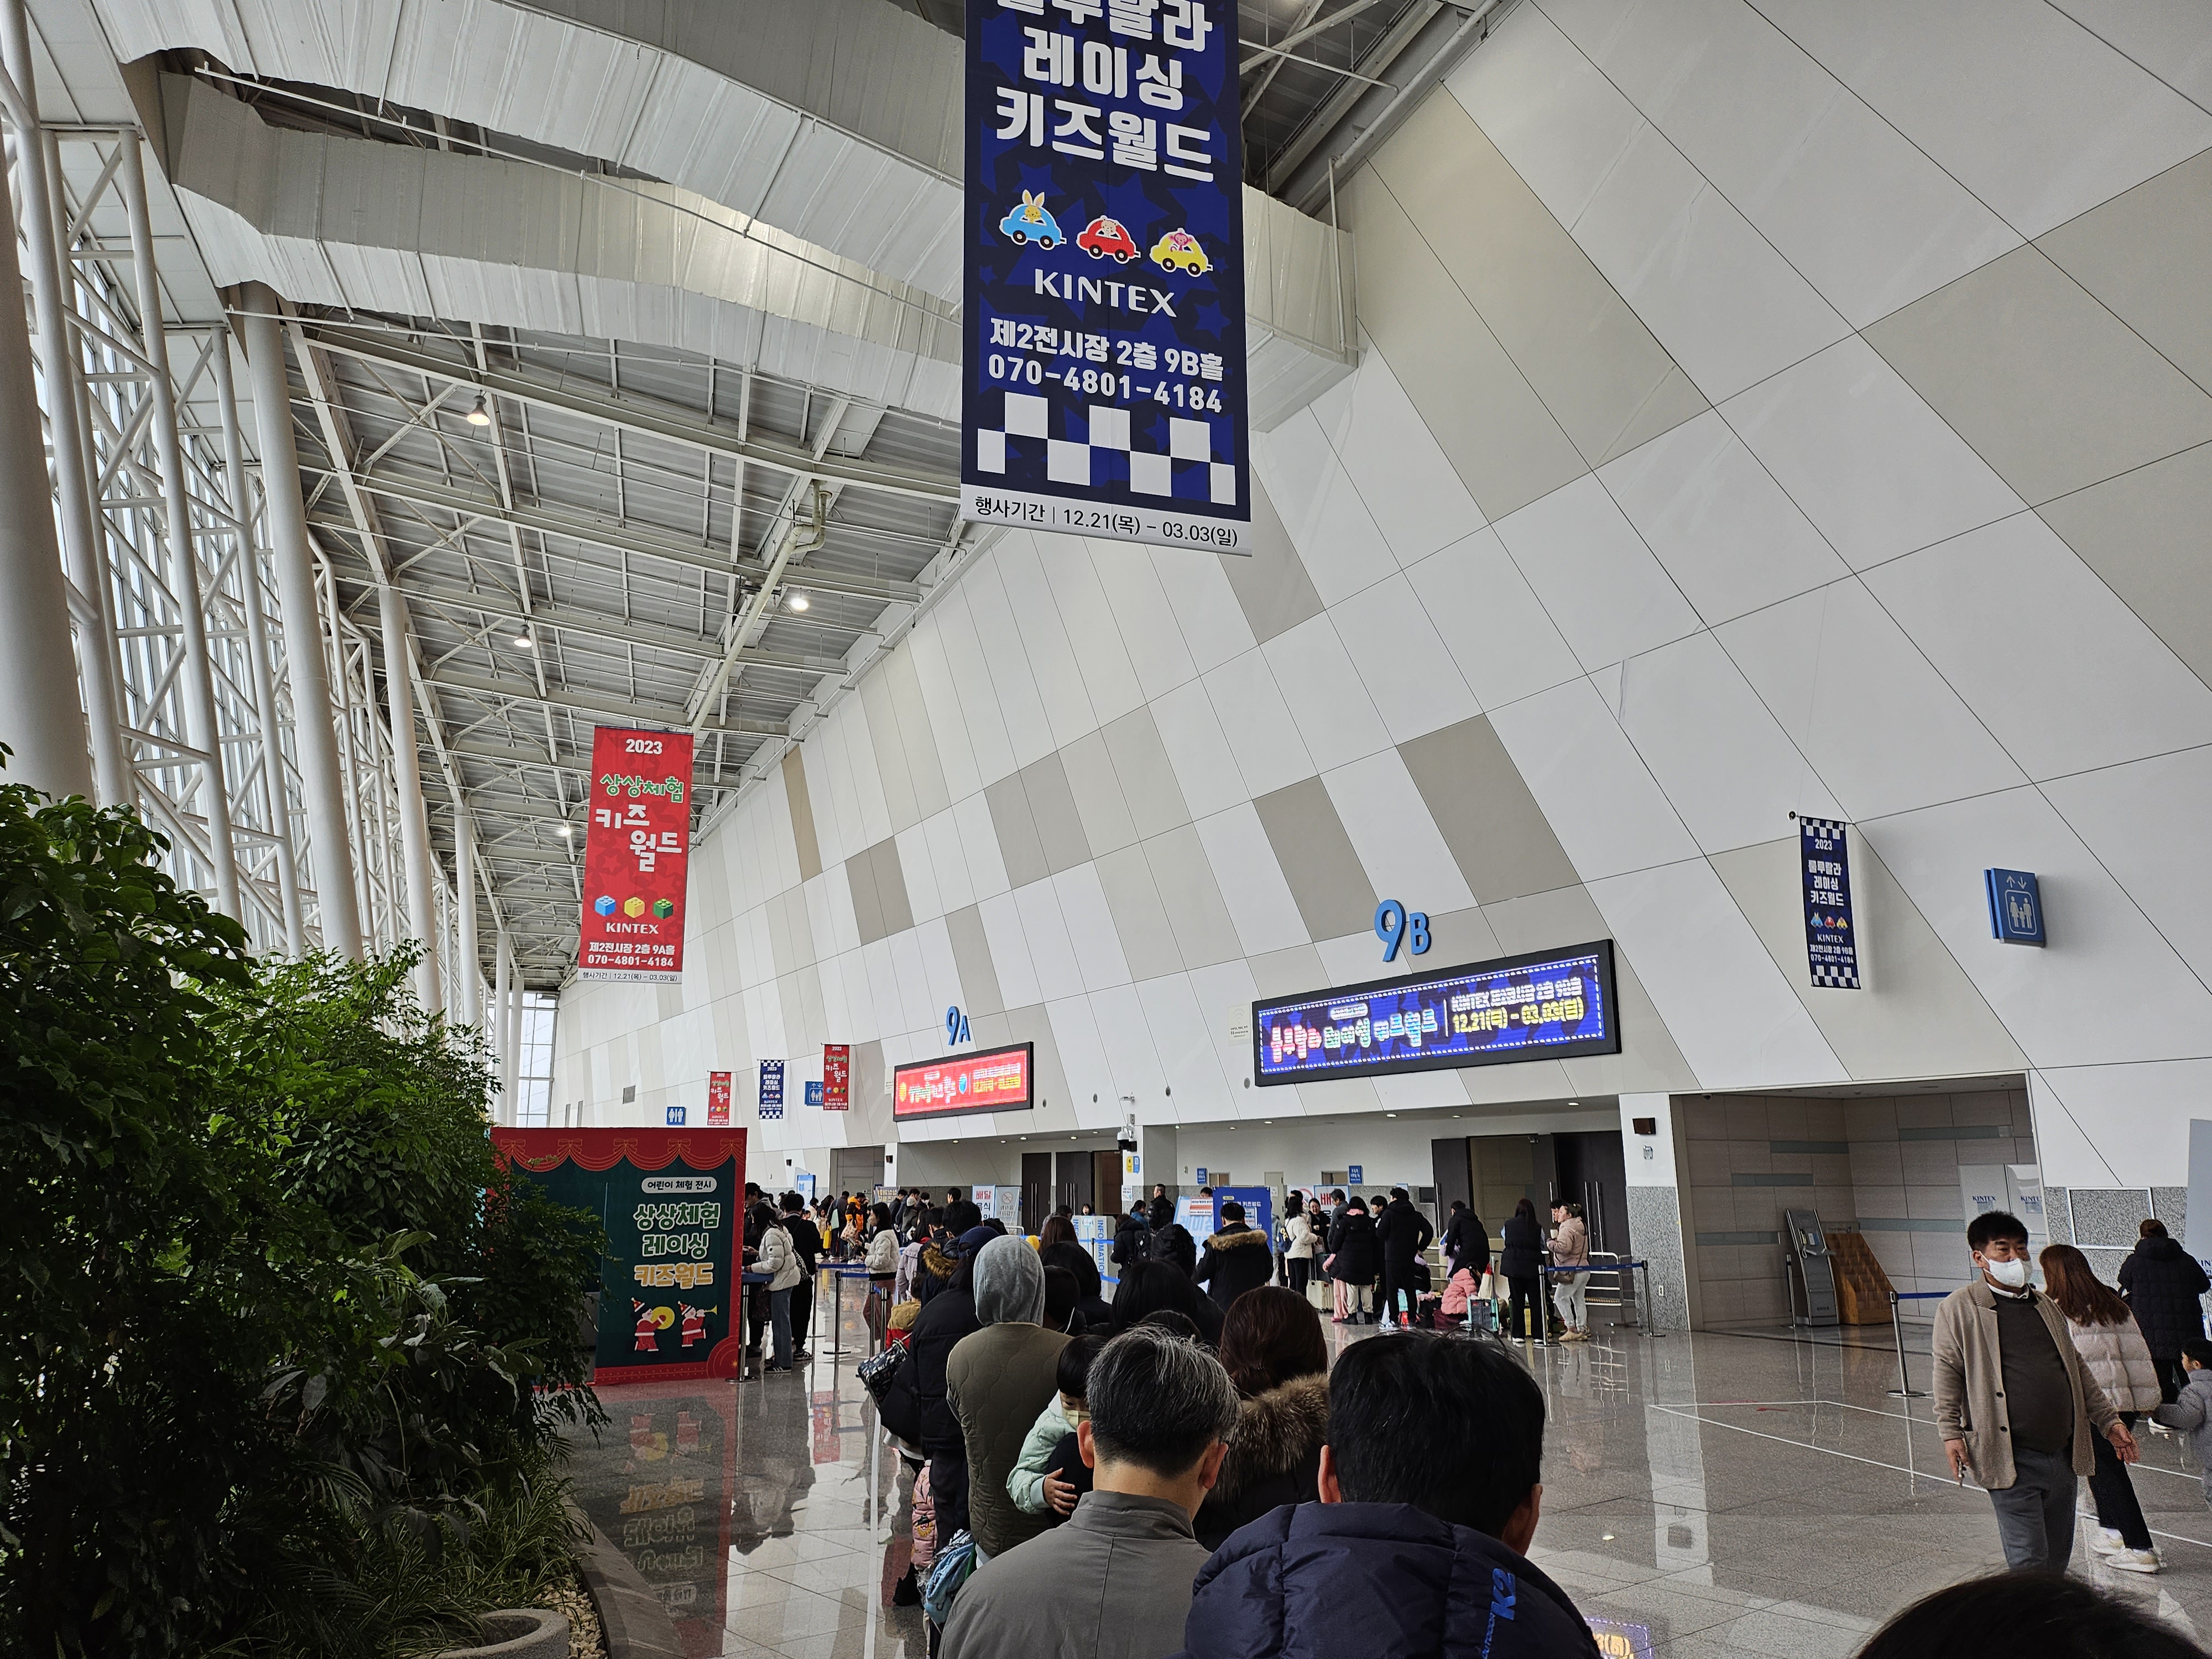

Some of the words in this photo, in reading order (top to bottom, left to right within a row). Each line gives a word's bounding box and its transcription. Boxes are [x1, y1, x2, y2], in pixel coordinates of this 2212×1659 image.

[1024, 26, 1183, 111] 레이싱
[997, 86, 1214, 182] 키즈월드
[1035, 269, 1177, 317] KINTEX
[990, 317, 1109, 363] 제2전시장
[1117, 341, 1157, 371] 2층
[1165, 348, 1224, 382] 9B홀
[989, 354, 1222, 413] 070-4801-4184
[975, 495, 1045, 523] 행사기간
[1063, 509, 1141, 536] 12.21(목)
[1162, 521, 1238, 547] 03.03(일)
[625, 739, 662, 755] 2023
[600, 774, 684, 803] 상상체험
[596, 804, 650, 828] 키즈
[630, 830, 682, 872] 월드
[1815, 838, 1832, 851] 2023
[1814, 875, 1839, 890] 레이싱
[1811, 890, 1844, 906] 키즈월드
[606, 922, 659, 935] KINTEX
[1374, 899, 1431, 962] 9B
[1817, 933, 1844, 943] KINTEX
[588, 954, 674, 967] 070-4801-4184
[589, 942, 633, 953] 제2전시장
[635, 944, 650, 954] 2층
[653, 945, 675, 956] 9A홀
[1811, 954, 1854, 964] 070-4801-4184
[946, 1006, 971, 1046] 9A
[648, 1181, 673, 1190] 어린이
[676, 1180, 693, 1190] 체험
[695, 1181, 711, 1189] 전시
[976, 1191, 991, 1199] 배달
[633, 1202, 720, 1230] 상상체험
[643, 1233, 709, 1260] 레이싱
[634, 1262, 714, 1290] 키즈월드
[1491, 1568, 1516, 1620] K2
